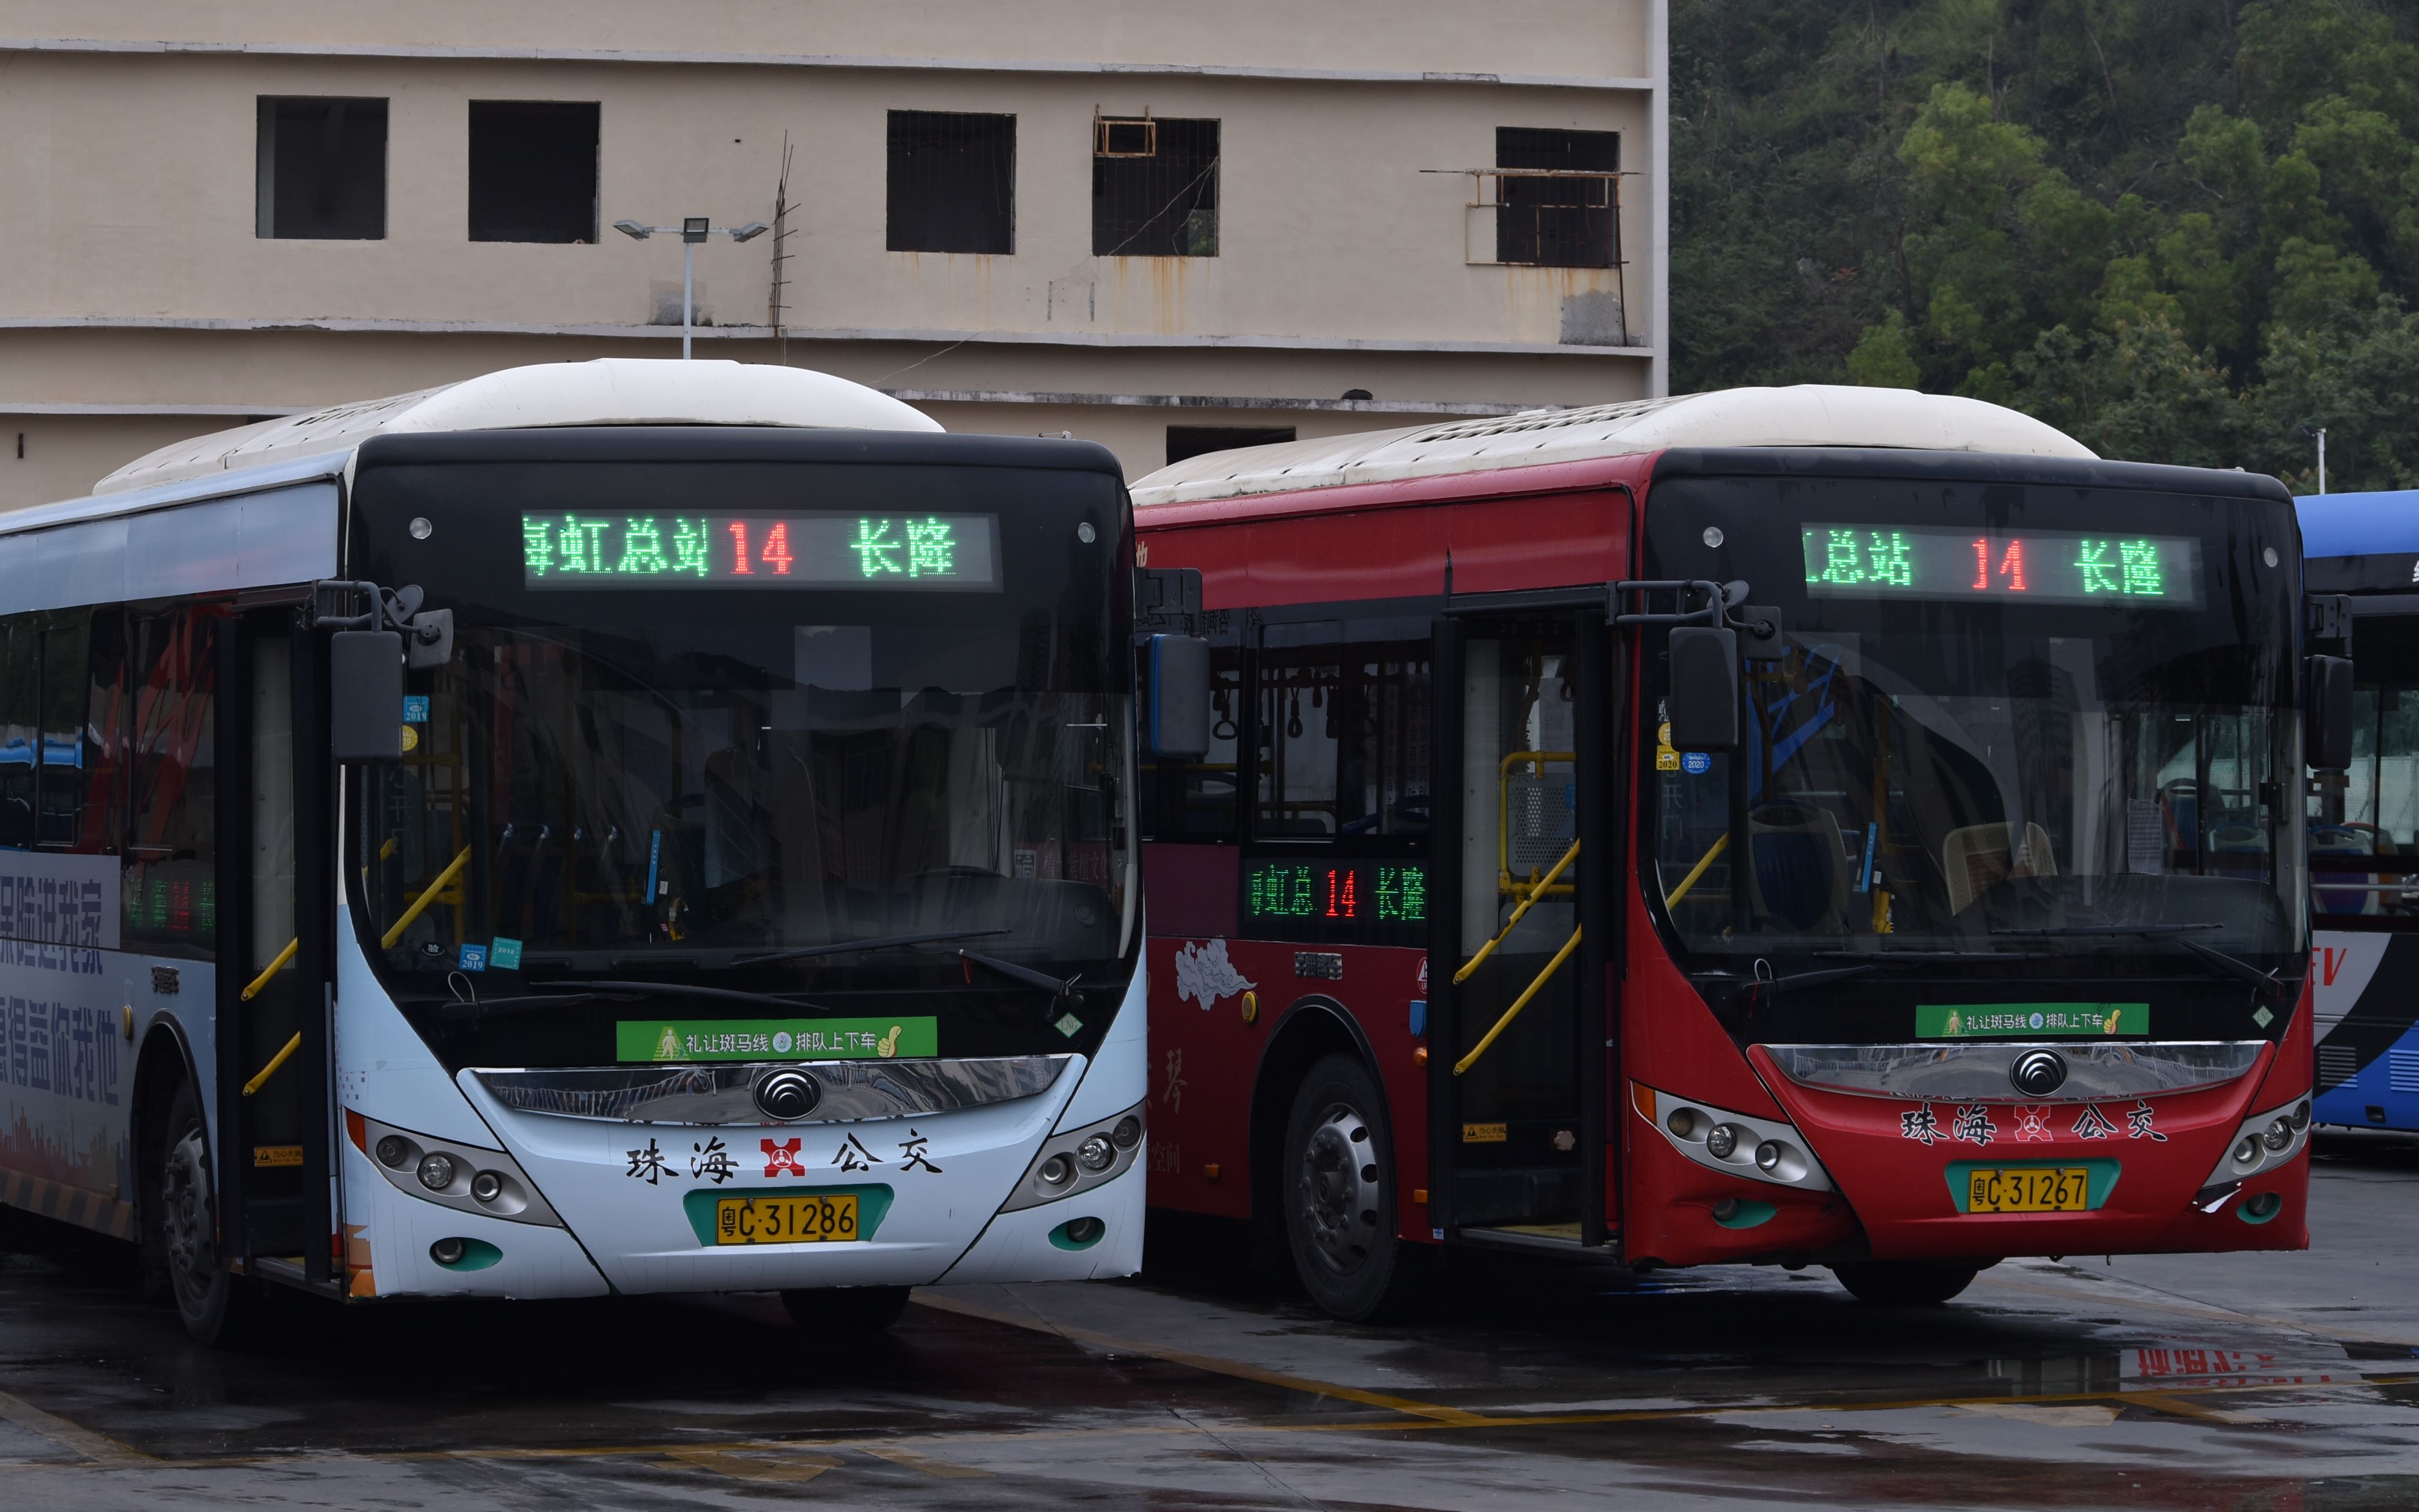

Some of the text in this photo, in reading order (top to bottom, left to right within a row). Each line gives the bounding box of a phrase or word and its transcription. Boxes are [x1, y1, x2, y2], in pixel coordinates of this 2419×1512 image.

[729, 523, 793, 575] 14
[851, 517, 957, 578] 长隆
[1803, 530, 2164, 594] 总站 14 长隆
[406, 712, 427, 720] 2018
[1659, 760, 1678, 769] 2020
[1326, 870, 1356, 917] 14
[1375, 867, 1426, 920] 长隆
[462, 959, 483, 969] 2019
[1061, 1020, 1077, 1031] LNG
[1966, 1013, 2103, 1030] 礼让斑马线 排队上下车
[686, 1031, 876, 1053] 礼让斑马线 排队上下车
[1900, 1099, 2168, 1146] 珠海 公交
[625, 1128, 944, 1186] 珠海 公交
